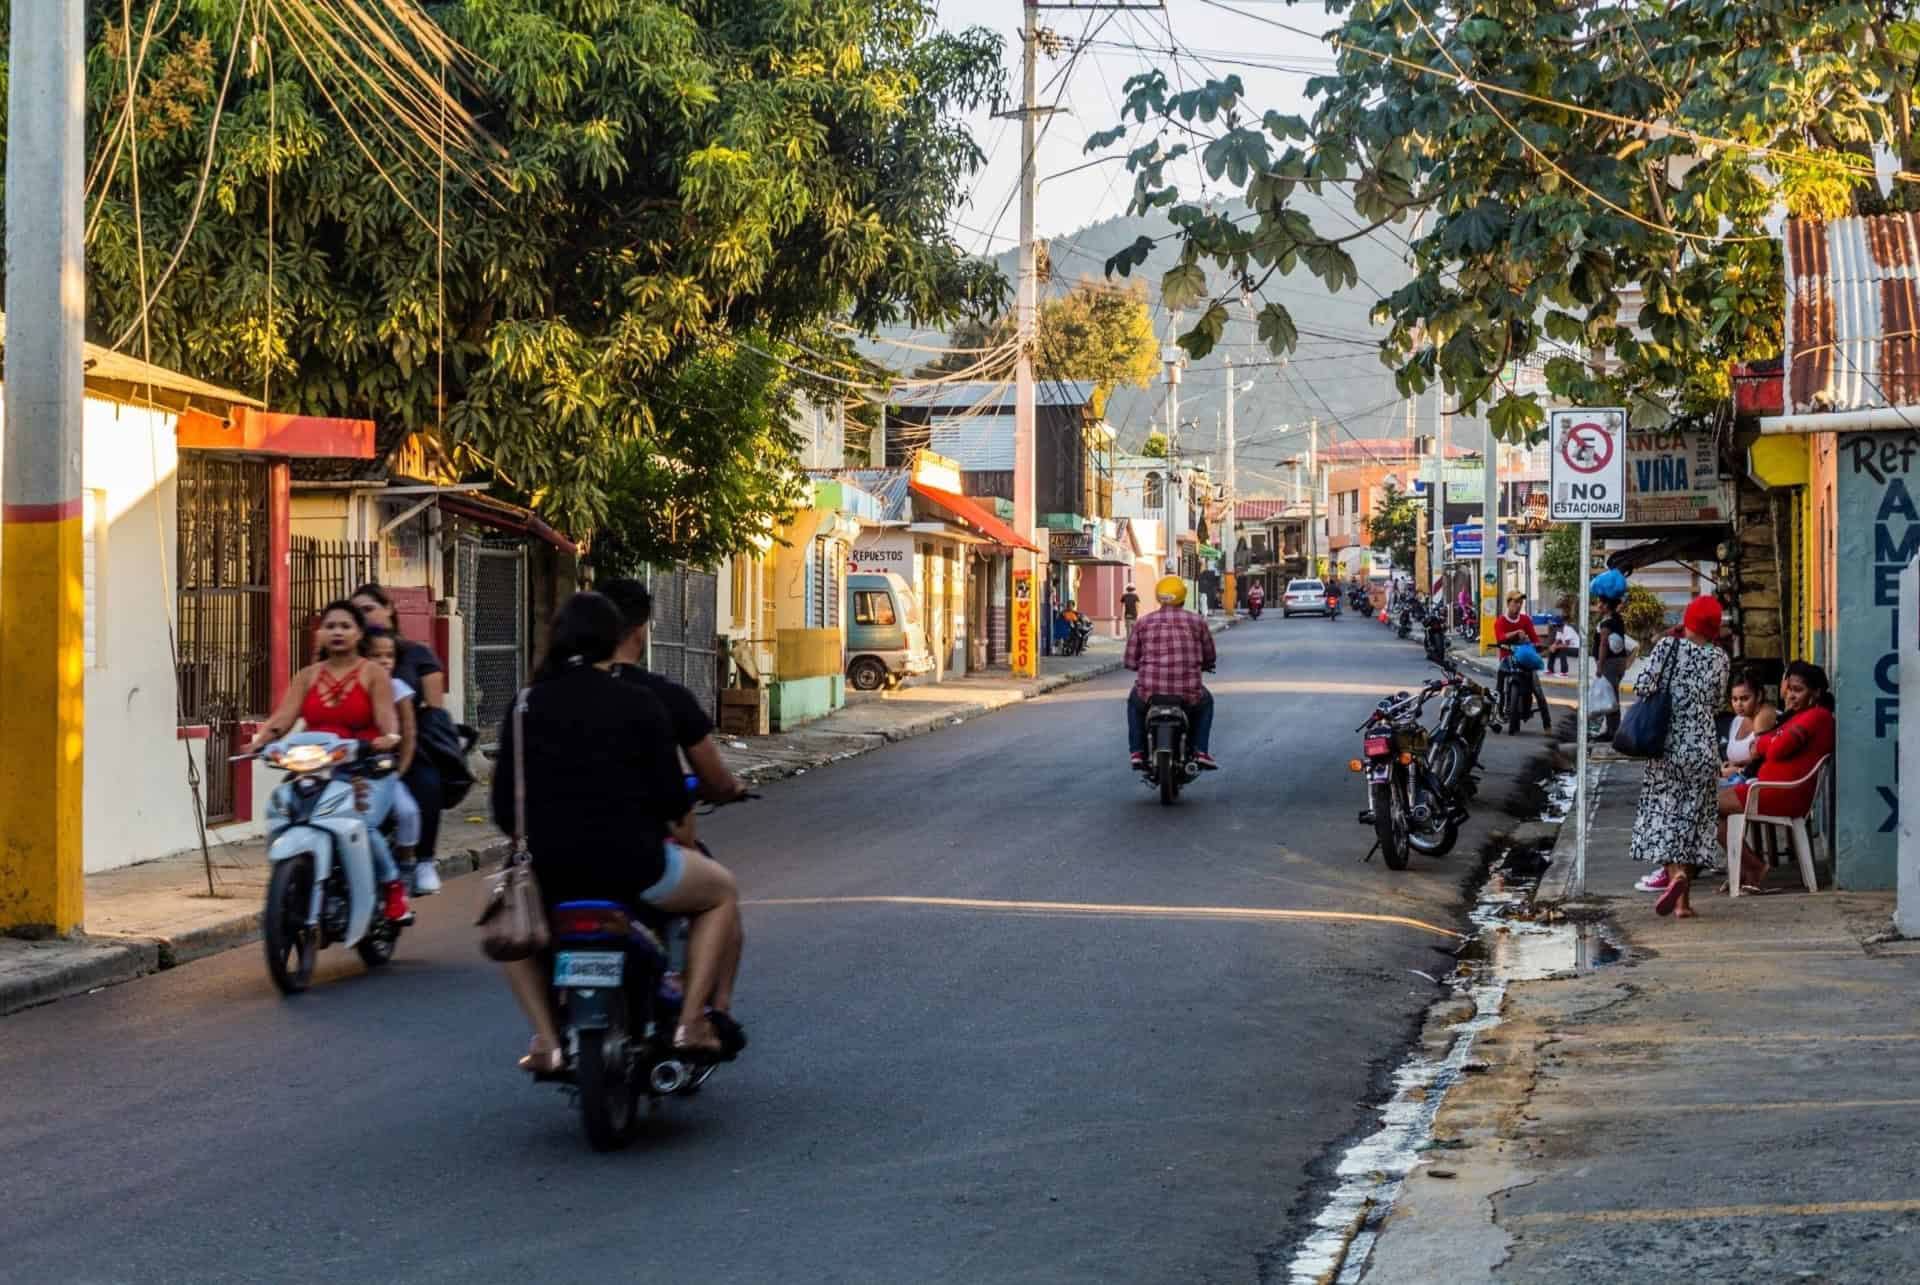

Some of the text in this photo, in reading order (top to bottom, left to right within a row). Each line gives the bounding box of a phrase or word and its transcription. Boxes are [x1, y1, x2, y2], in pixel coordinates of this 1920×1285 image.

[1636, 454, 1688, 492] VIÑA
[1571, 483, 1607, 500] NO
[1554, 502, 1621, 514] ESTACIONAR
[853, 550, 903, 561] REPUESTOS
